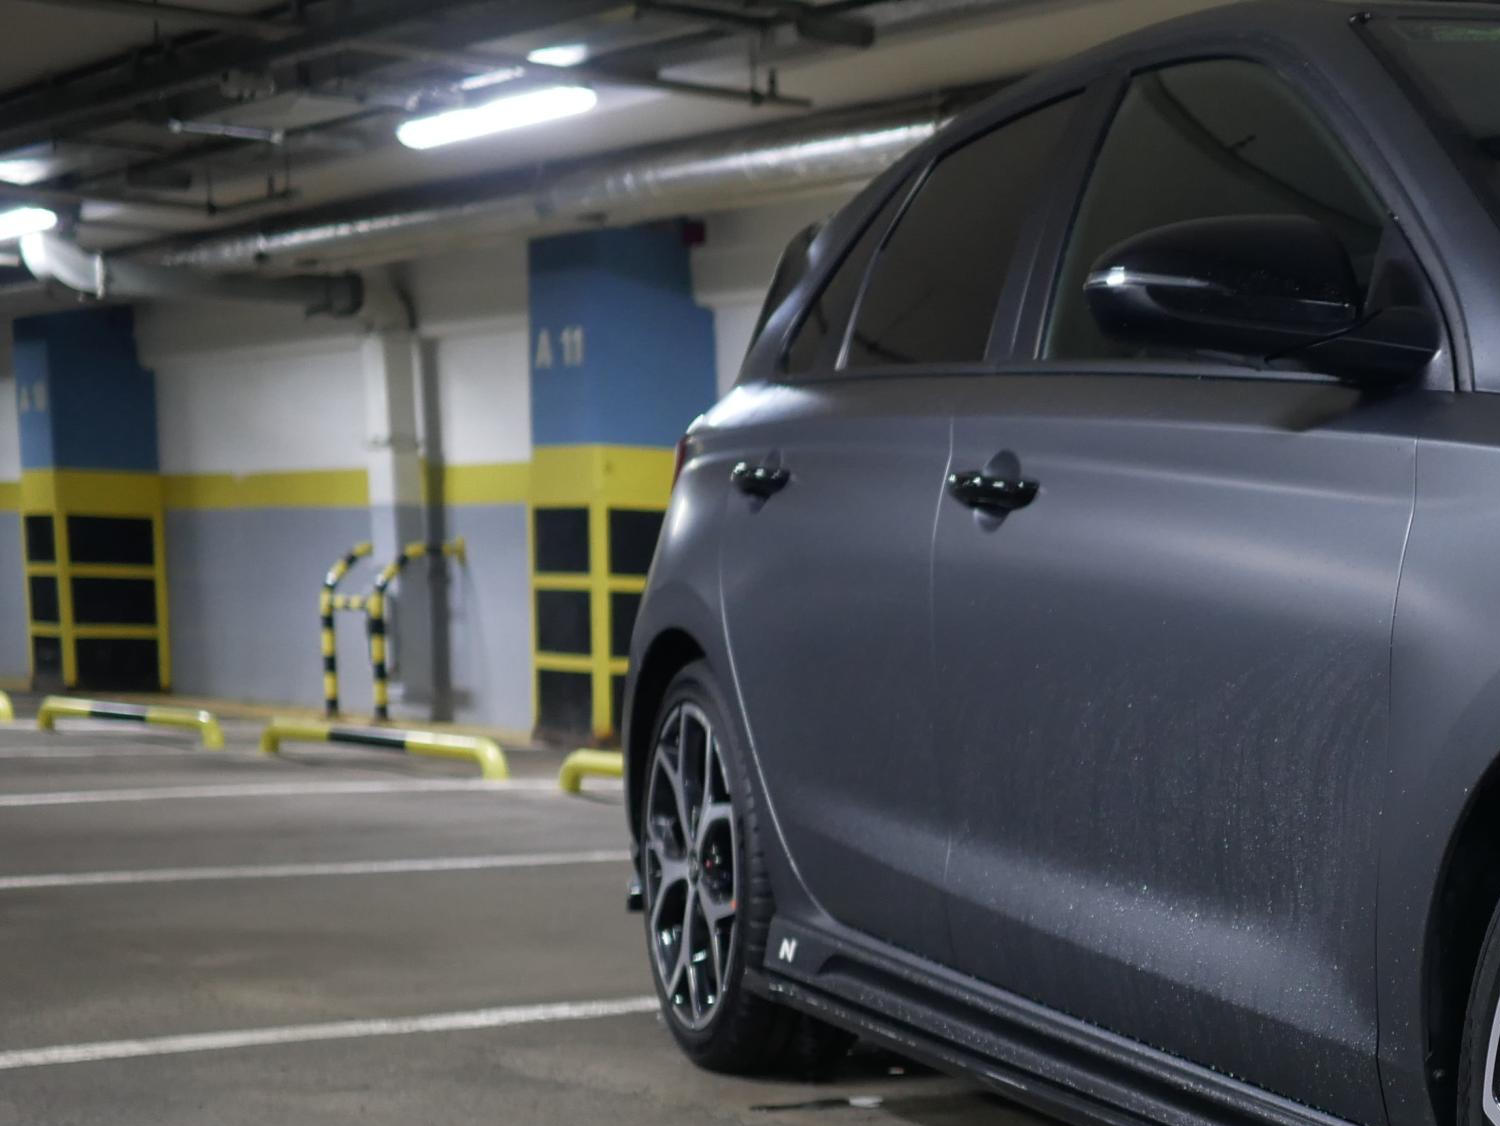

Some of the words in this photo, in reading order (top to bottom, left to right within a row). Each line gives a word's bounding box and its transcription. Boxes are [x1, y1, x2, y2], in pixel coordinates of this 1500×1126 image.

[535, 328, 552, 369] A
[561, 325, 584, 368] 11
[779, 938, 797, 962] N
